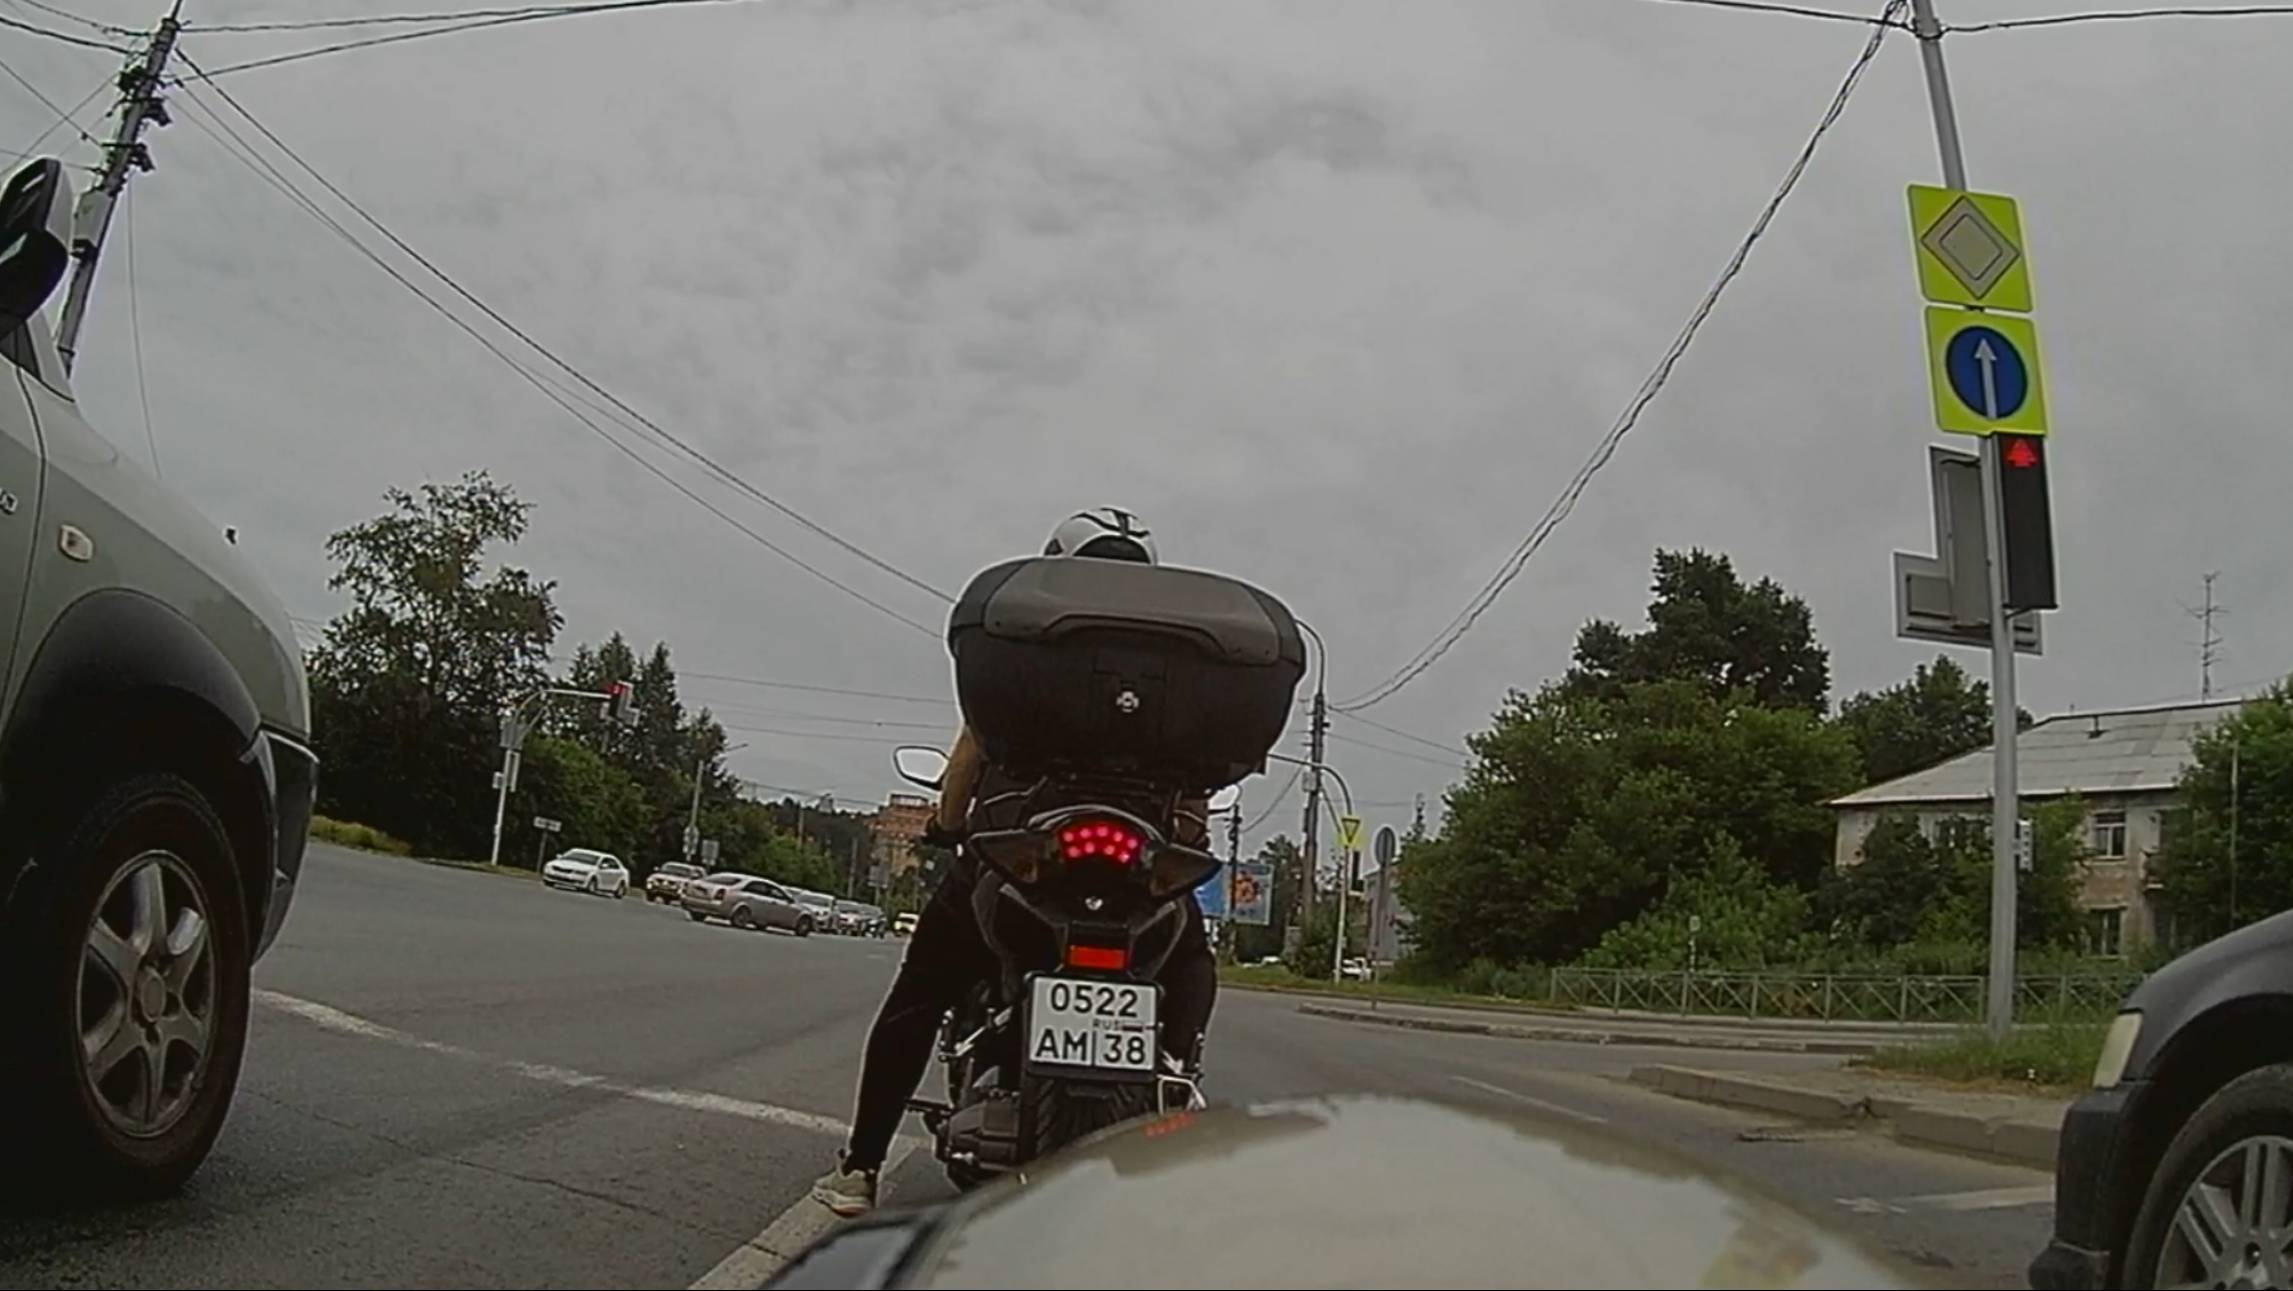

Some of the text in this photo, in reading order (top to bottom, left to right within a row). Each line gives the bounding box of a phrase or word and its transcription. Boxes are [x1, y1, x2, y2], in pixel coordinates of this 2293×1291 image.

[1050, 983, 1138, 1018] 0522
[1035, 1028, 1146, 1065] AM 38
